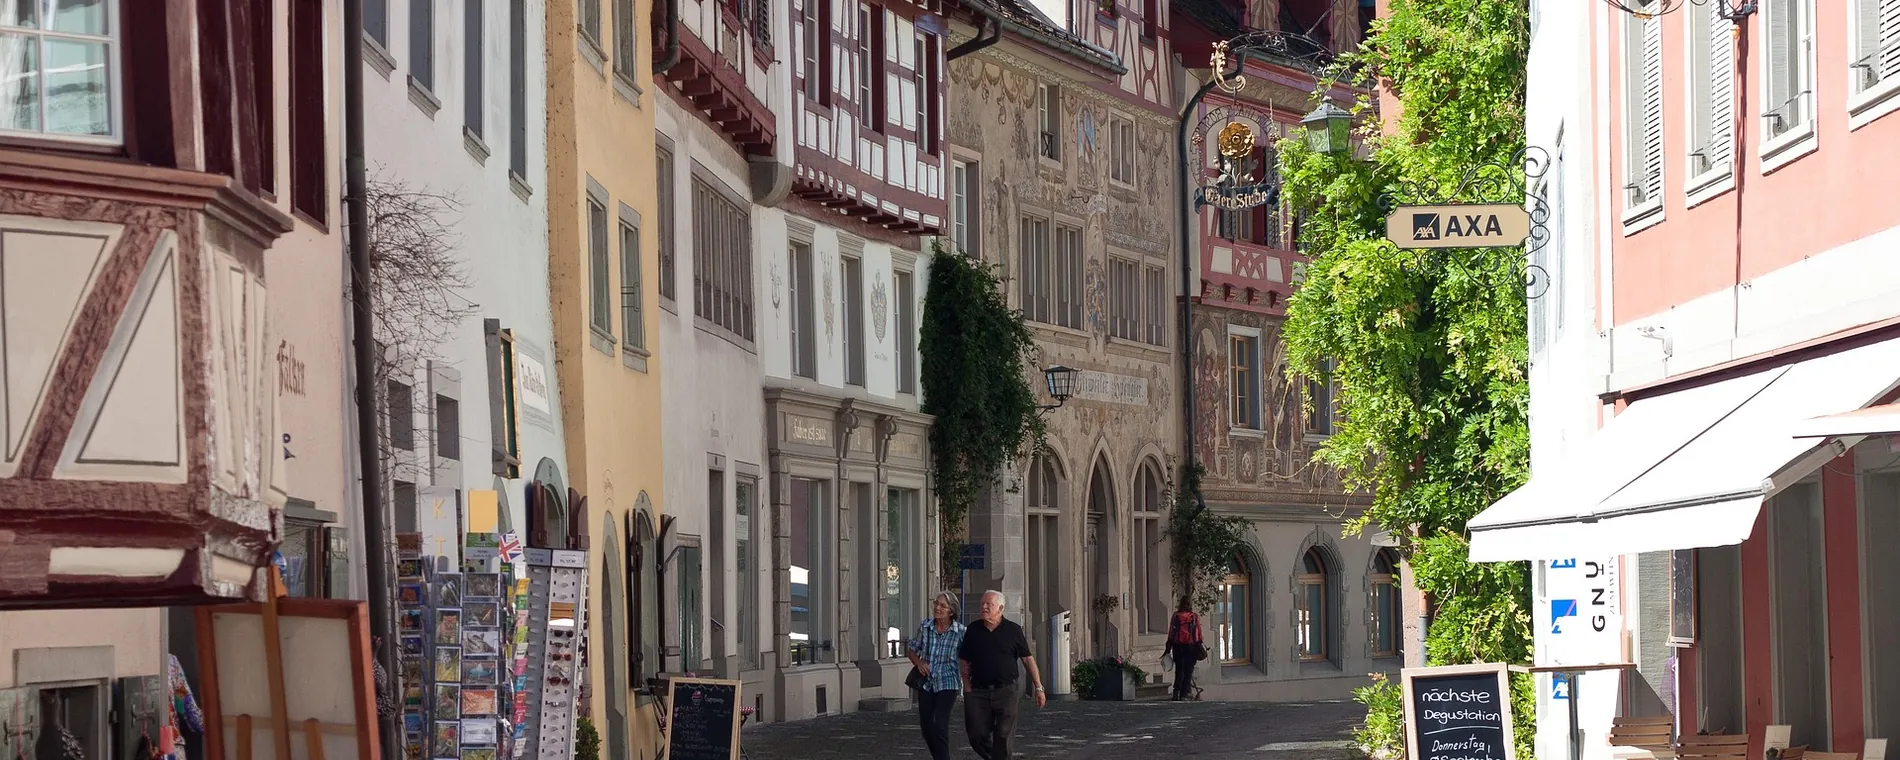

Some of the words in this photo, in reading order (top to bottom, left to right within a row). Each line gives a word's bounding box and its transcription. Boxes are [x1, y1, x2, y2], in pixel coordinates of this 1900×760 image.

[1413, 226, 1436, 239] AXA
[1445, 214, 1503, 237] AXA
[1423, 709, 1500, 725] Degustation
